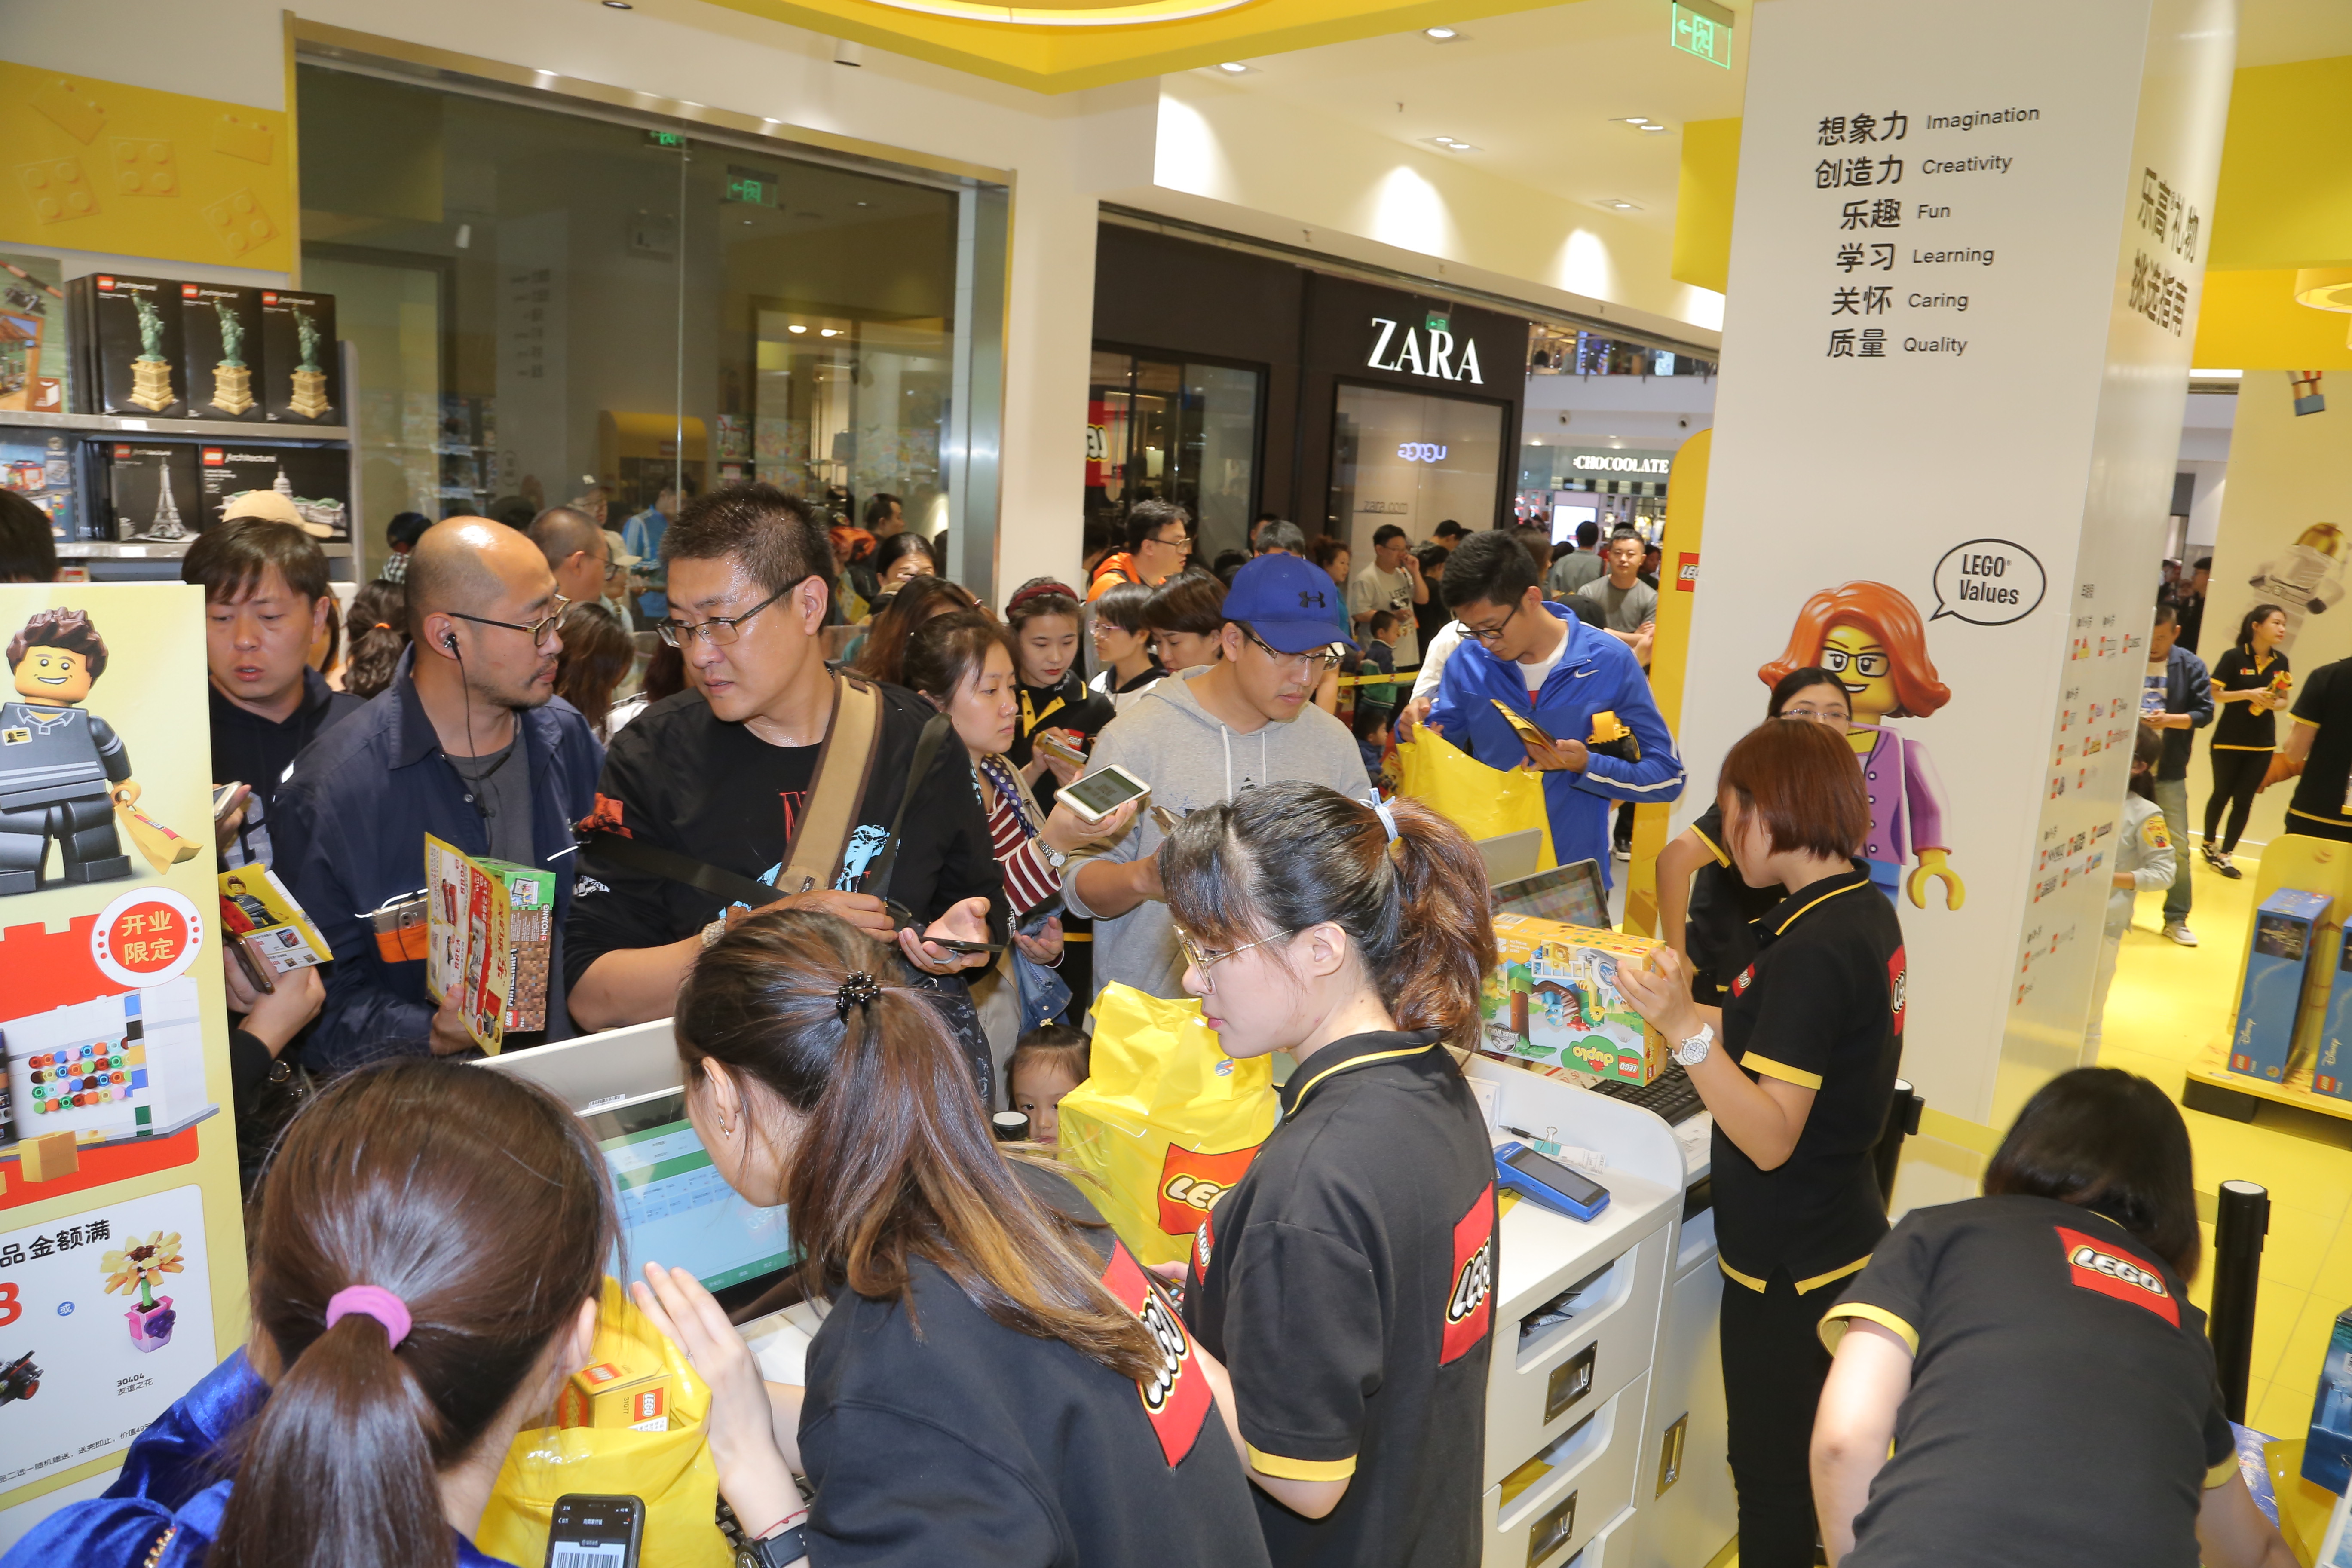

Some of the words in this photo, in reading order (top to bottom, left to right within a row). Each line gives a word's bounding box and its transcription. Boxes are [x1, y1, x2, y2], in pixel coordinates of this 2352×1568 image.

[1818, 110, 1908, 146] 想象力
[1926, 107, 2040, 132] Imagination
[1815, 155, 1904, 190] 创造力
[1922, 155, 2012, 175] Creativity
[1840, 199, 1902, 230] 乐趣
[1917, 203, 1951, 220] Fun
[1836, 242, 1896, 273] 学习
[1912, 248, 1995, 267] Learning
[1831, 285, 1893, 316] 关怀
[1908, 293, 1969, 311] Caring
[2128, 248, 2188, 337] 挑选指南
[1367, 317, 1484, 385] ZARA
[1827, 328, 1888, 358] 质量
[1903, 337, 1968, 357] Quality
[1959, 579, 2019, 605] Values
[1068, 736, 1083, 745] EGO
[121, 910, 172, 937] 开业
[124, 938, 175, 965] 限定
[505, 1011, 513, 1026] LEGO
[1572, 1046, 1614, 1066] duplo
[1619, 1062, 1637, 1073] LEGO
[1169, 1177, 1229, 1209] LE
[0, 1219, 111, 1268] 品金额满
[2073, 1247, 2163, 1295] LEGO
[59, 1303, 72, 1315] 或
[117, 1373, 145, 1387] 30404
[117, 1378, 153, 1396] 友谊之花
[643, 1393, 655, 1416] LEGO
